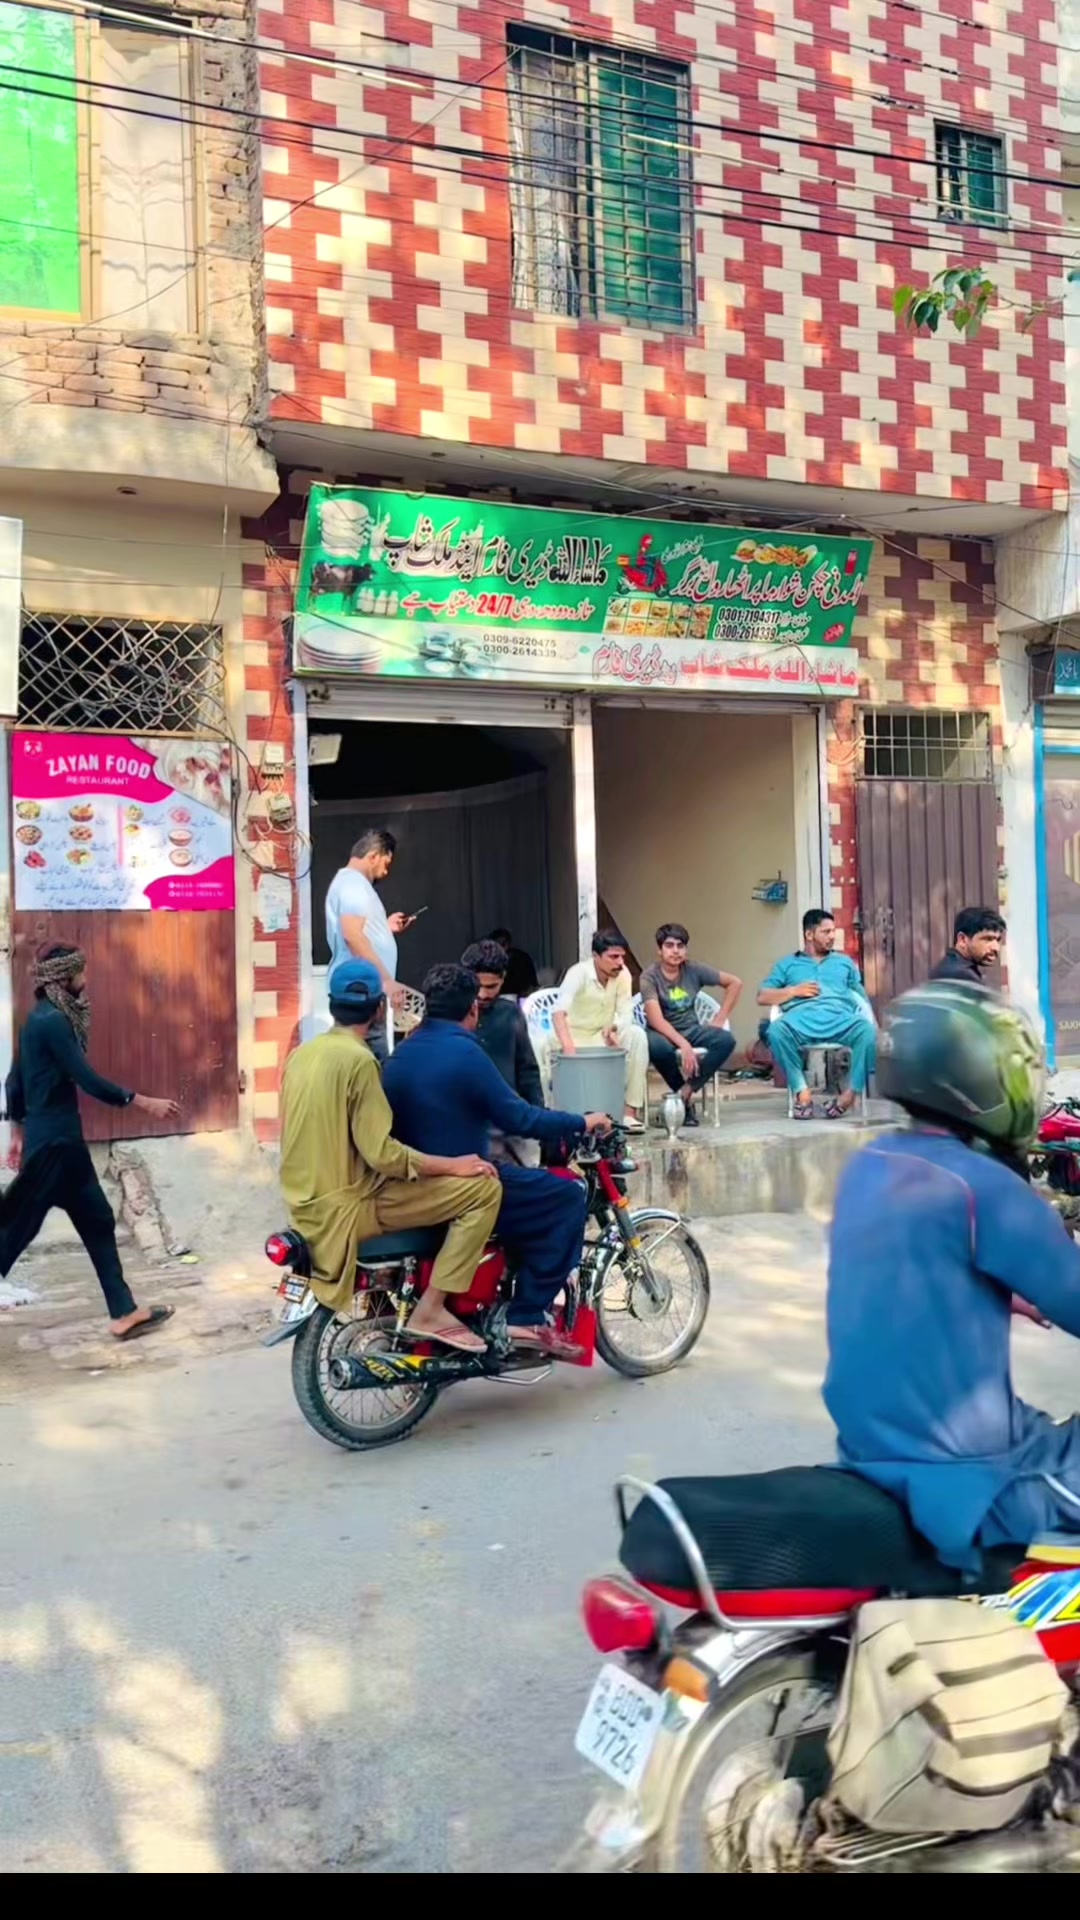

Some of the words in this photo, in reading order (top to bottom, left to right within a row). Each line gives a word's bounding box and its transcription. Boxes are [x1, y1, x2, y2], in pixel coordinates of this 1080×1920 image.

[383, 513, 433, 570] شاپ
[406, 516, 460, 568] ملک
[481, 534, 510, 577] فارم
[506, 539, 553, 588] ڈیری
[762, 570, 802, 603] شوارما
[792, 560, 831, 607] چکن
[820, 566, 864, 609] المدنی
[401, 591, 426, 617] ہے
[426, 589, 476, 617] دستیاب
[477, 593, 513, 616] 24/7
[718, 607, 781, 624] 0301-7194317
[482, 633, 557, 648] 0309-6220475
[714, 624, 777, 641] 0300-2614339
[482, 644, 557, 659] 0300-2614339
[592, 640, 624, 681] فارم
[622, 643, 662, 685] ڈیری
[680, 648, 726, 684] شاپ
[727, 651, 771, 681] ملک
[46, 754, 99, 777] ZAYAN
[105, 755, 151, 780] FOOD
[66, 775, 129, 785] RESTAURANT
[592, 1720, 638, 1775] 9726
